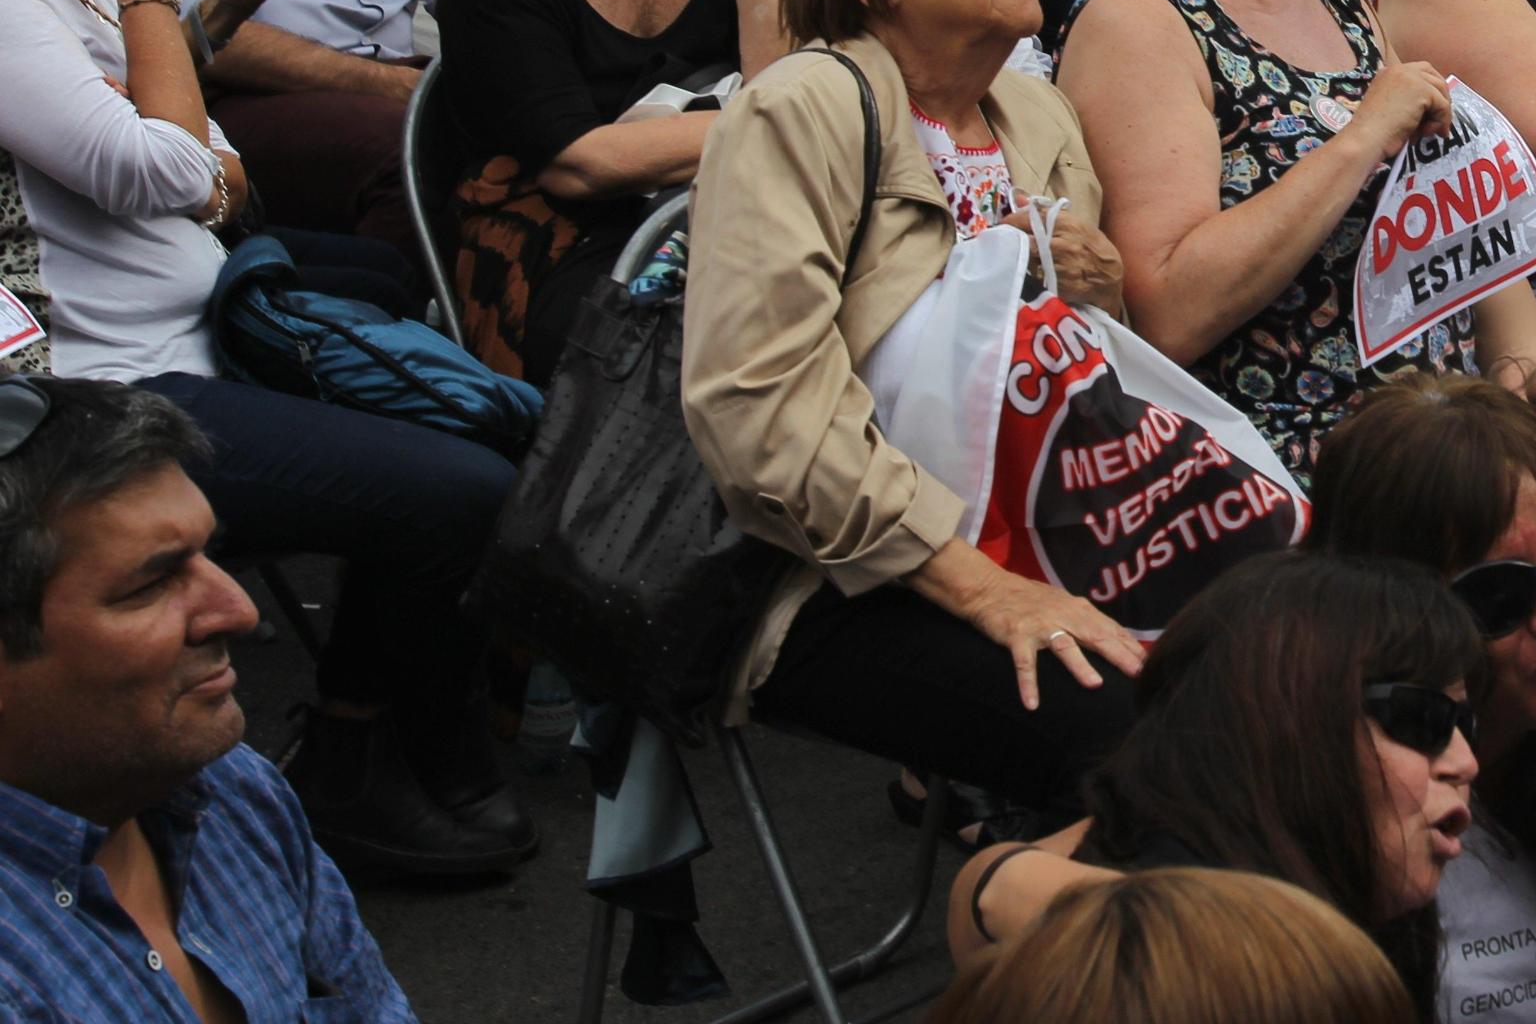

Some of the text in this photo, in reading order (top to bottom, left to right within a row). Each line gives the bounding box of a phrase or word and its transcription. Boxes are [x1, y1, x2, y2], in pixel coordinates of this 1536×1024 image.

[1395, 104, 1480, 184] IGAN
[1372, 138, 1528, 276] DÓNDE
[1407, 218, 1517, 307] ESTÁN
[1059, 403, 1183, 492] MEMO
[1083, 432, 1232, 547] VERDA
[1088, 470, 1289, 605] JUSTICIA
